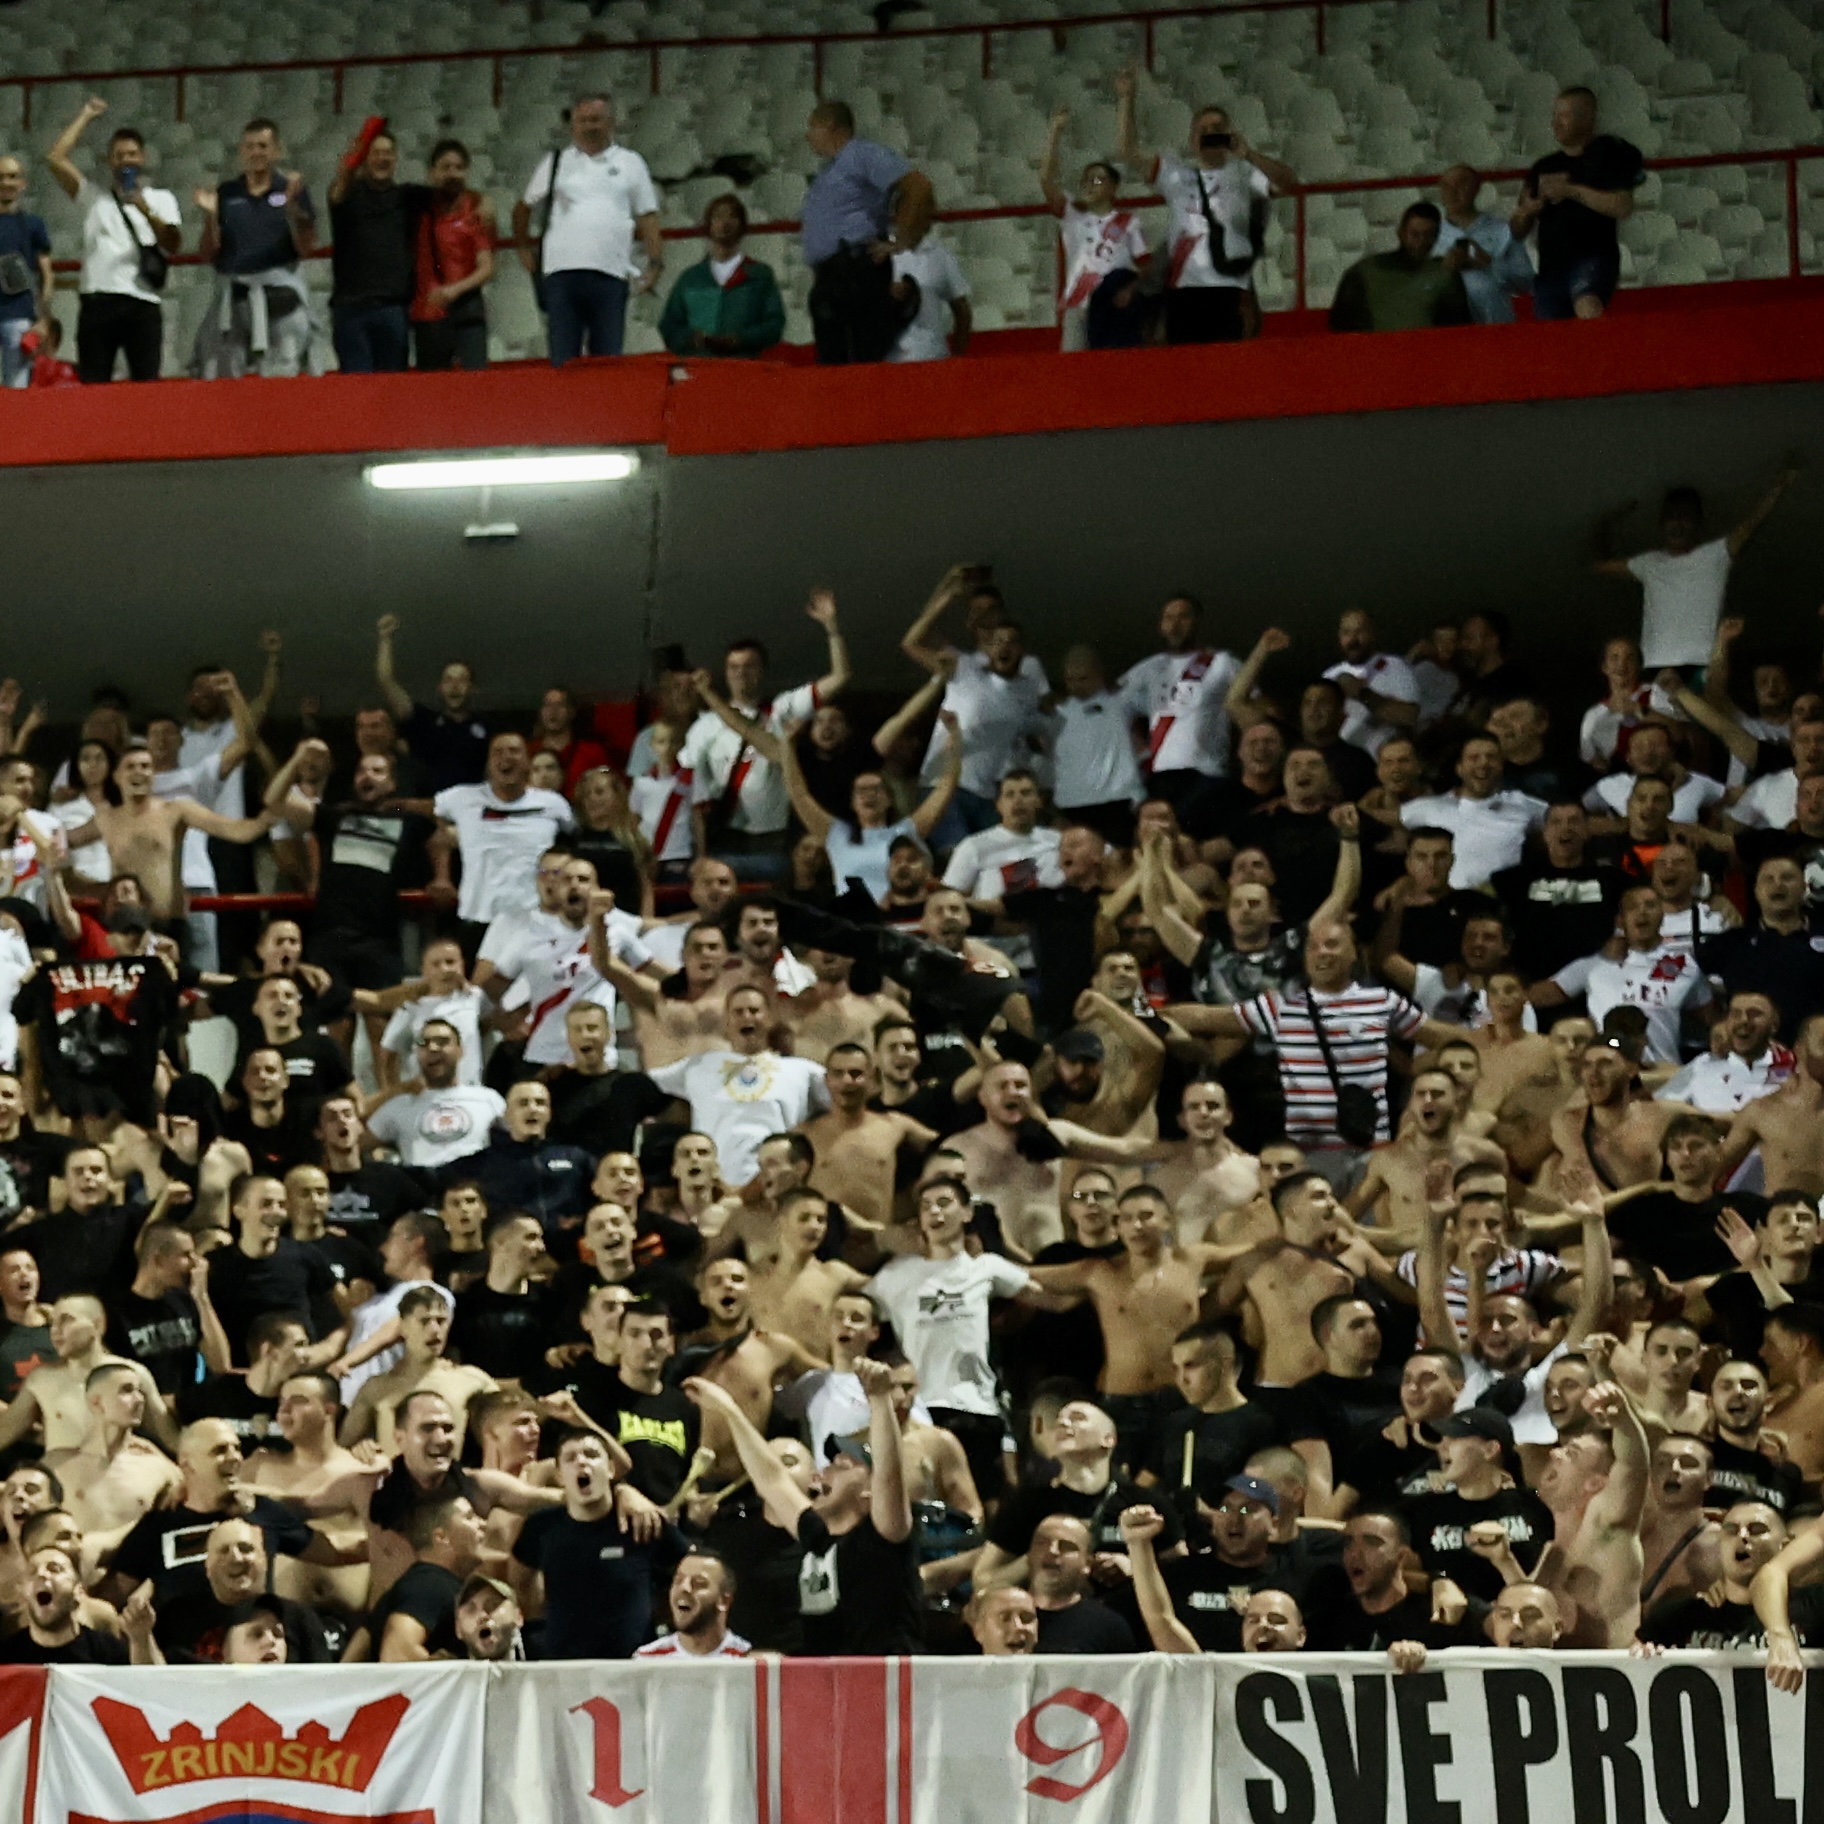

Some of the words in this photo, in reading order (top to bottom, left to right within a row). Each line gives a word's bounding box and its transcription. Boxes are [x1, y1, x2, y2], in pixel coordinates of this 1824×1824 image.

[139, 1740, 362, 1787] ZRINJSKI
[567, 1695, 645, 1809] 1
[1013, 1685, 1130, 1804] 9
